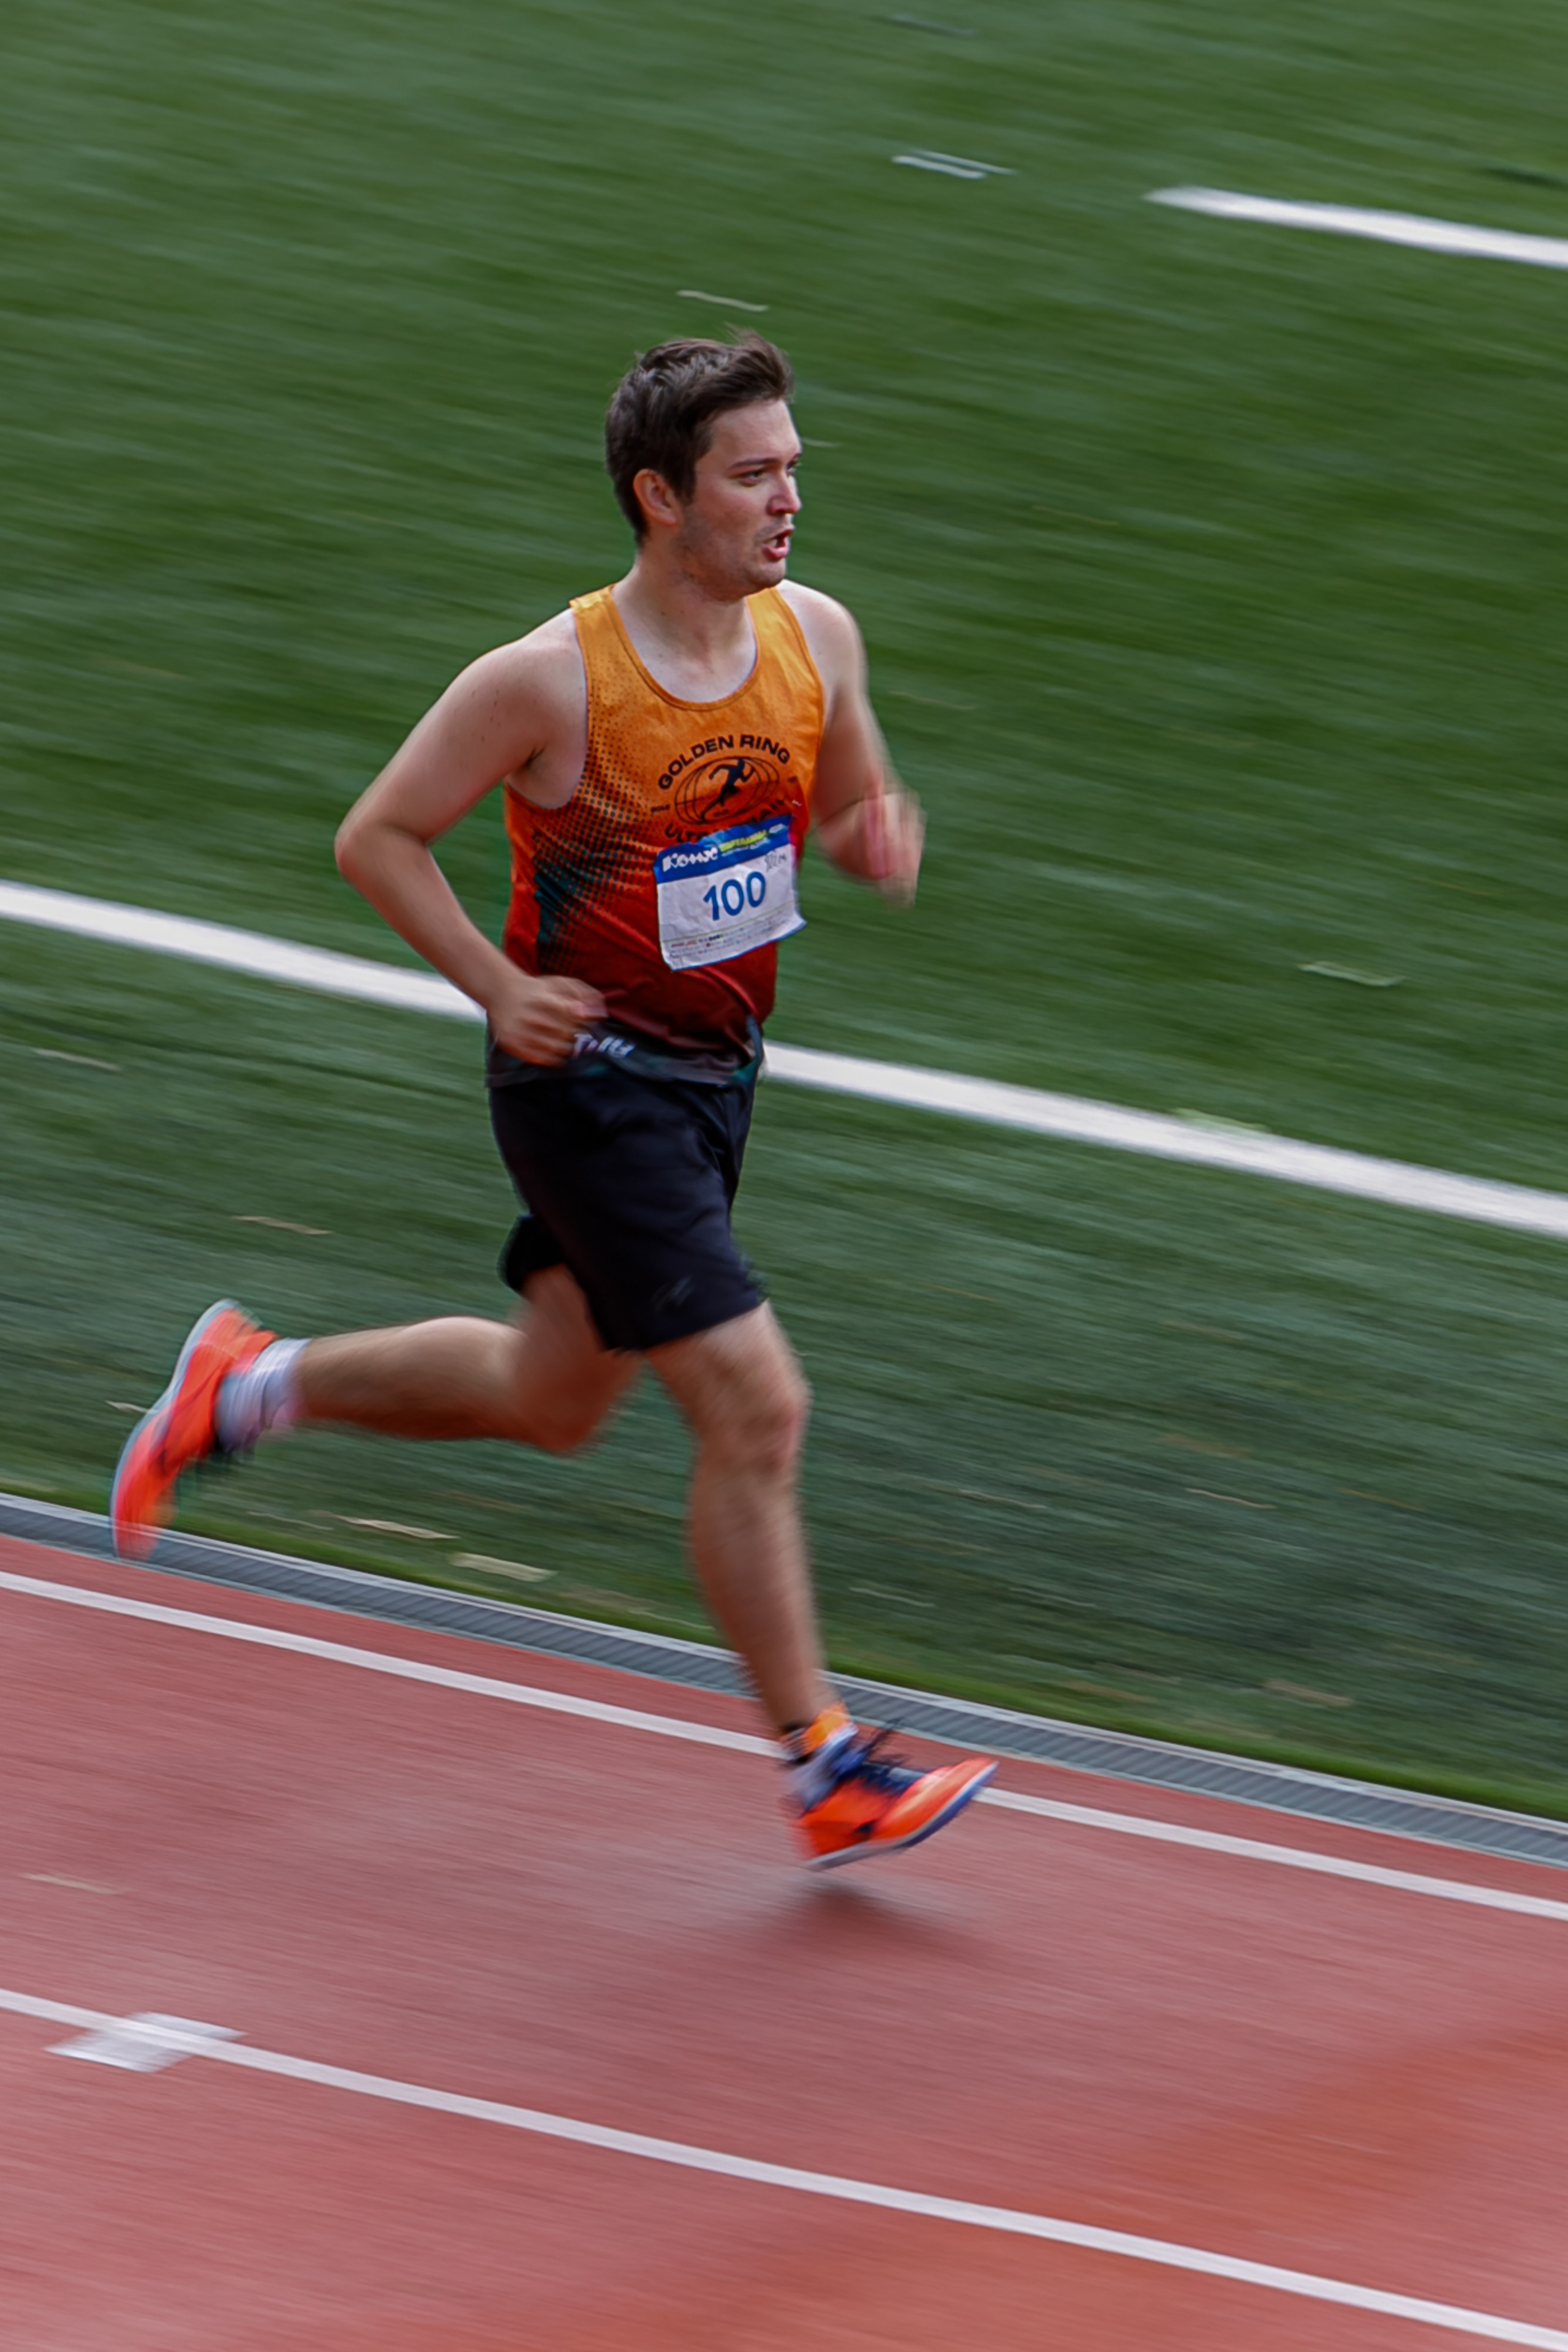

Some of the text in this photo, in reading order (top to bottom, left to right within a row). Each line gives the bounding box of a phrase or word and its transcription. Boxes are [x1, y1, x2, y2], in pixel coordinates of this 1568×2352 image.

[658, 734, 790, 790] GOLDEN RING
[703, 870, 766, 921] 100
